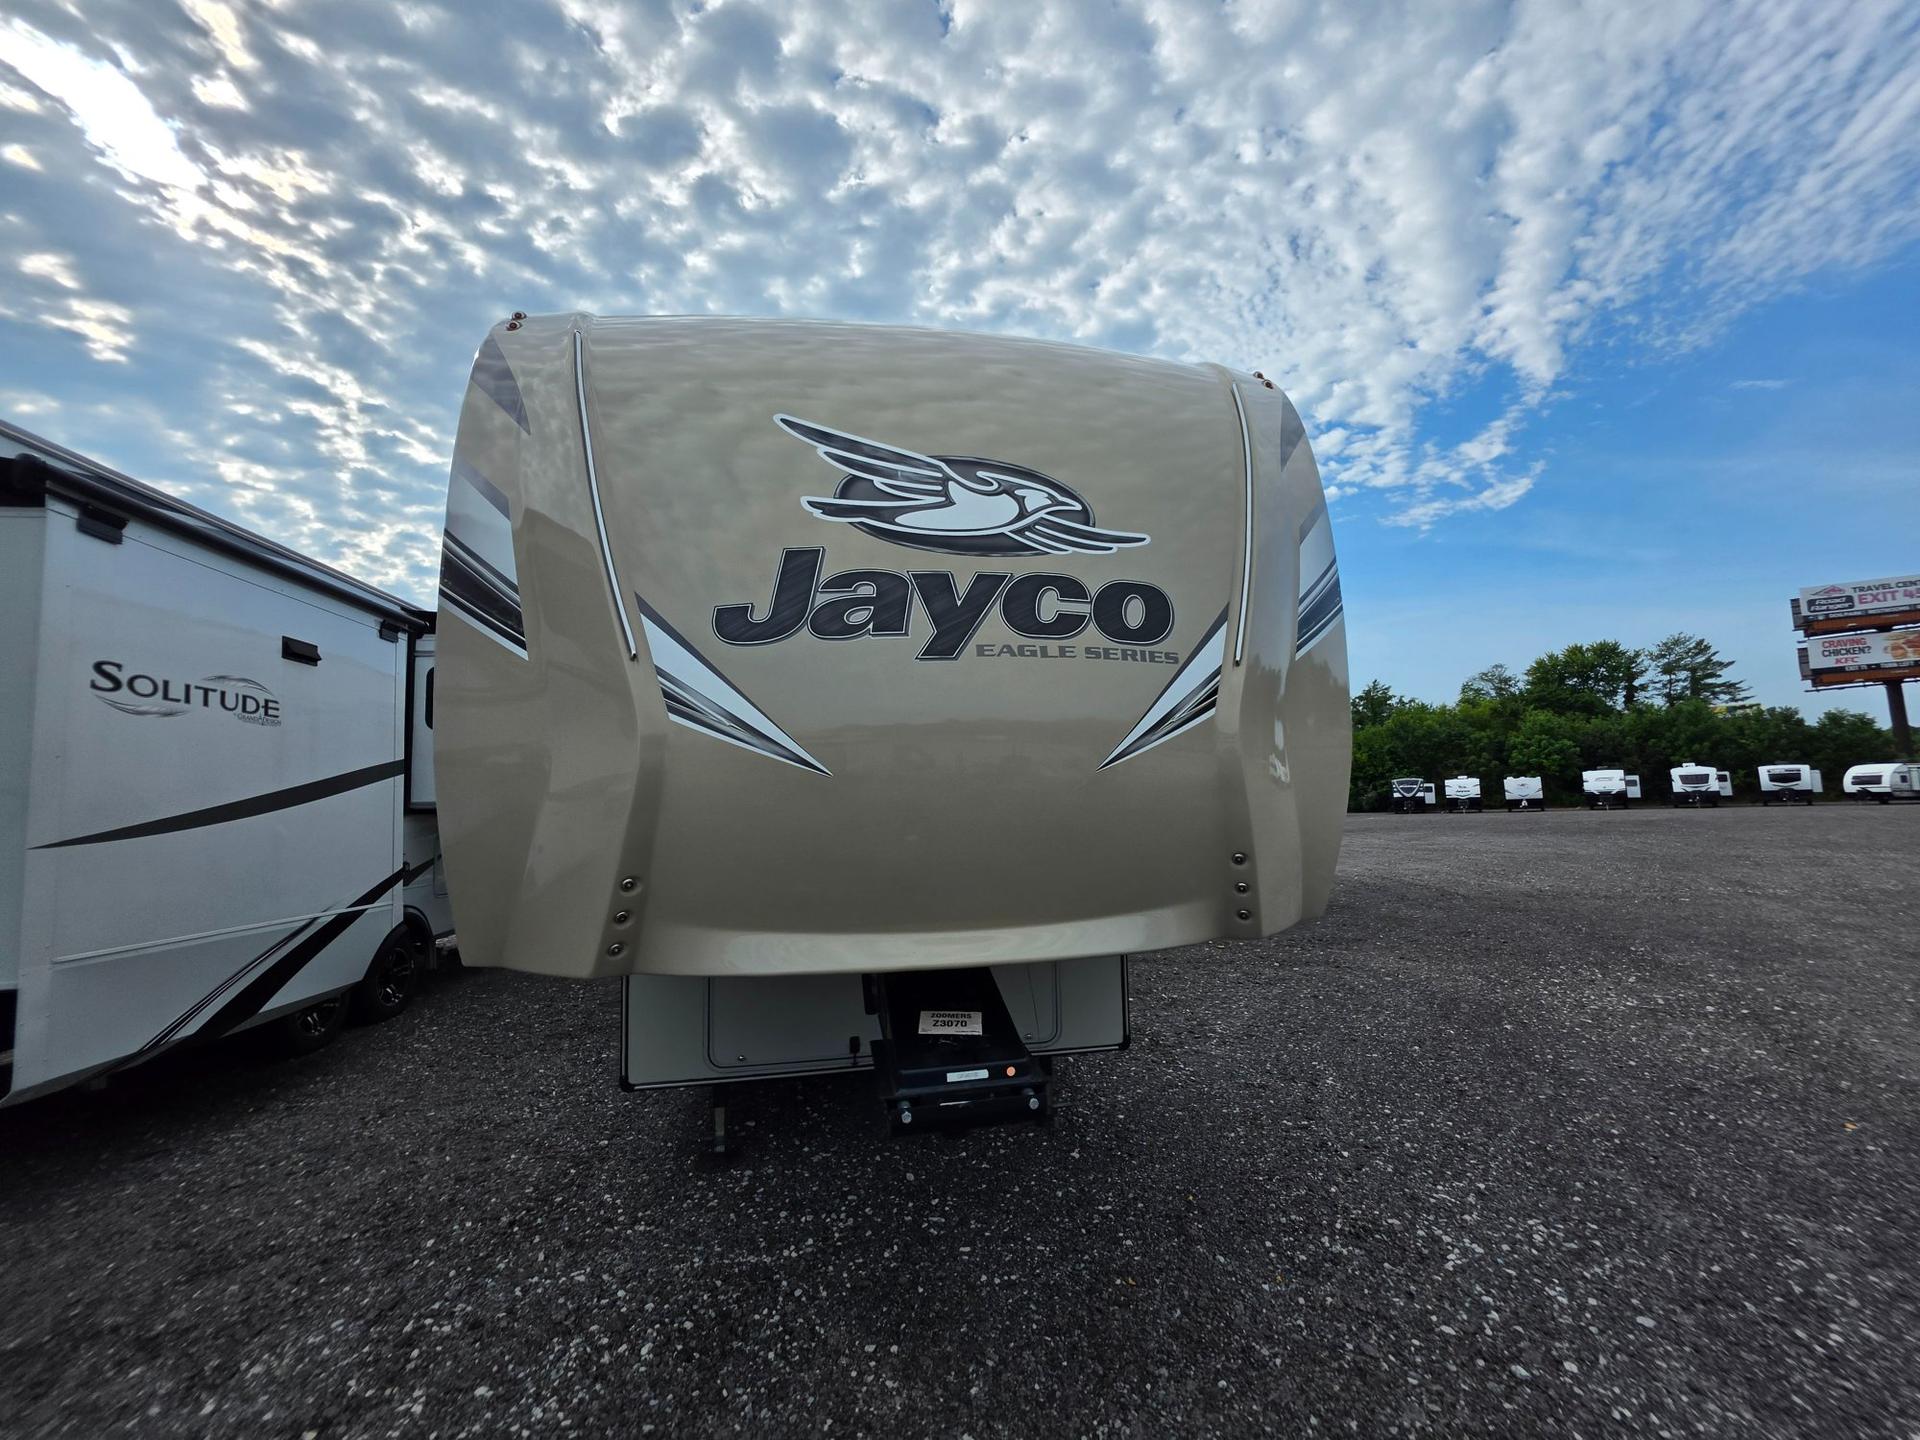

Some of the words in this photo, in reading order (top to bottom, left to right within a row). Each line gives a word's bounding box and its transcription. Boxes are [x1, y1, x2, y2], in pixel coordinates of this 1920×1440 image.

[1851, 583, 1894, 593] TRAVEL
[1858, 590, 1898, 604] EXIT
[711, 545, 1175, 661] Jayco
[1822, 637, 1867, 649] CRAVING
[975, 643, 1077, 659] EAGLE
[1085, 646, 1180, 664] SERIES
[1822, 646, 1872, 657] CHICKEN?
[1834, 656, 1860, 665] KFC
[932, 1019, 967, 1027] Z3070
